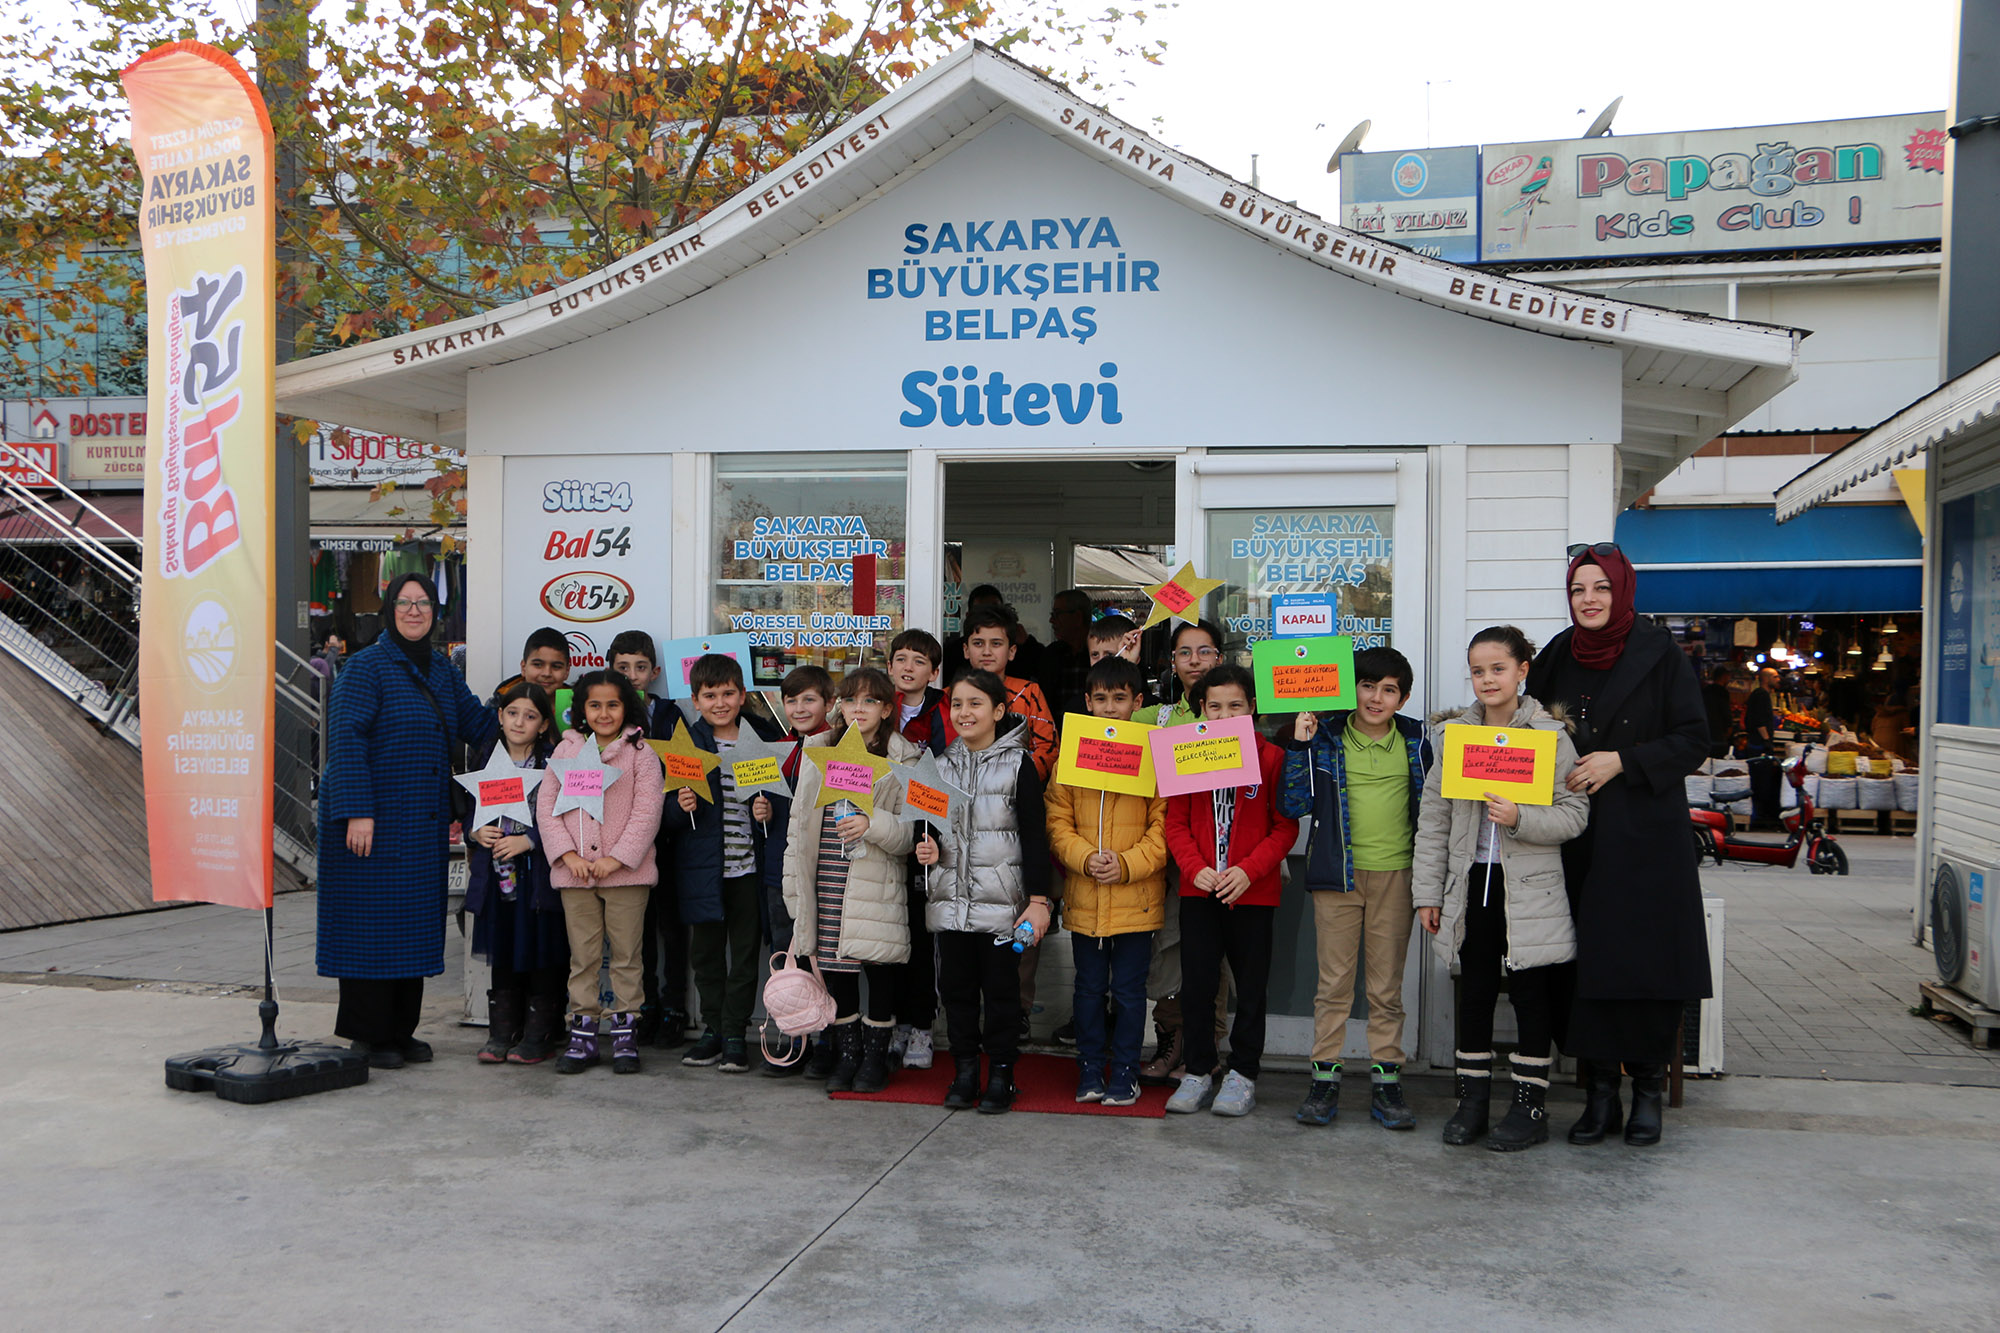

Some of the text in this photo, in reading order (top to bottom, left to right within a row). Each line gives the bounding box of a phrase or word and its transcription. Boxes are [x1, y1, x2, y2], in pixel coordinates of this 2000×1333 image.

[1577, 142, 1883, 201] Papağan
[1060, 107, 1174, 181] SAKARYA
[1220, 191, 1397, 275] BÜYÜKŞEHİR
[1391, 208, 1467, 233] YILDIZ
[1596, 209, 1694, 241] Kids
[1717, 200, 1825, 232] Club
[904, 217, 1120, 255] SAKARYA
[868, 252, 1159, 301] BÜYÜKŞEHİR
[926, 305, 1096, 345] BELPAŞ
[393, 323, 505, 366] SAKARYA
[900, 362, 1122, 427] Sütevi
[69, 413, 125, 436] DOST
[543, 480, 633, 513] Süt54
[754, 516, 867, 536] SAKARYA
[1252, 514, 1379, 534] SAKARYA
[362, 539, 394, 551] GİYİM
[734, 535, 888, 561] BÜYÜKŞEHİR
[765, 564, 853, 586] BELPAŞ
[1266, 563, 1367, 588] BELPAŞ
[564, 585, 619, 610] et54
[730, 612, 892, 630] YÖRESEL ÜRÜNLER
[1282, 614, 1326, 625] KAPALI
[748, 631, 873, 649] SATIŞ NOKTASI
